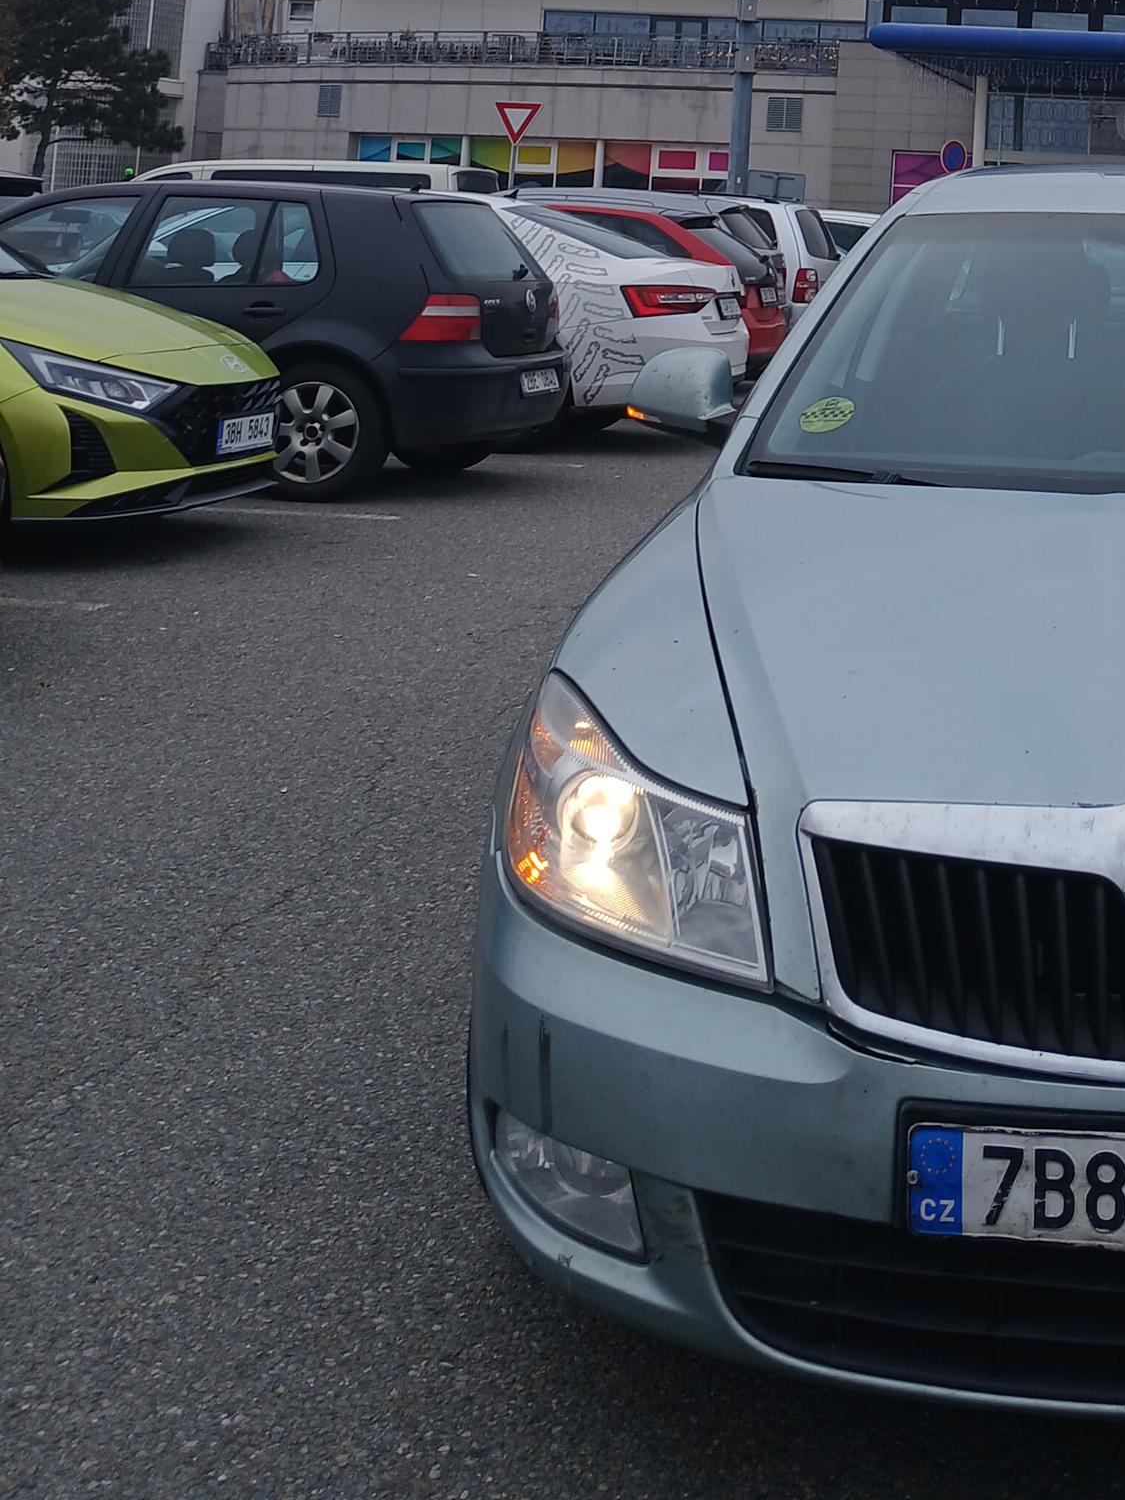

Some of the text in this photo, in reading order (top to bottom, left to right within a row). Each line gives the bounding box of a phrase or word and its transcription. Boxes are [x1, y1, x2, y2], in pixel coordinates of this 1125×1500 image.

[225, 416, 270, 444] 3BH 5843
[920, 1198, 956, 1222] CZ
